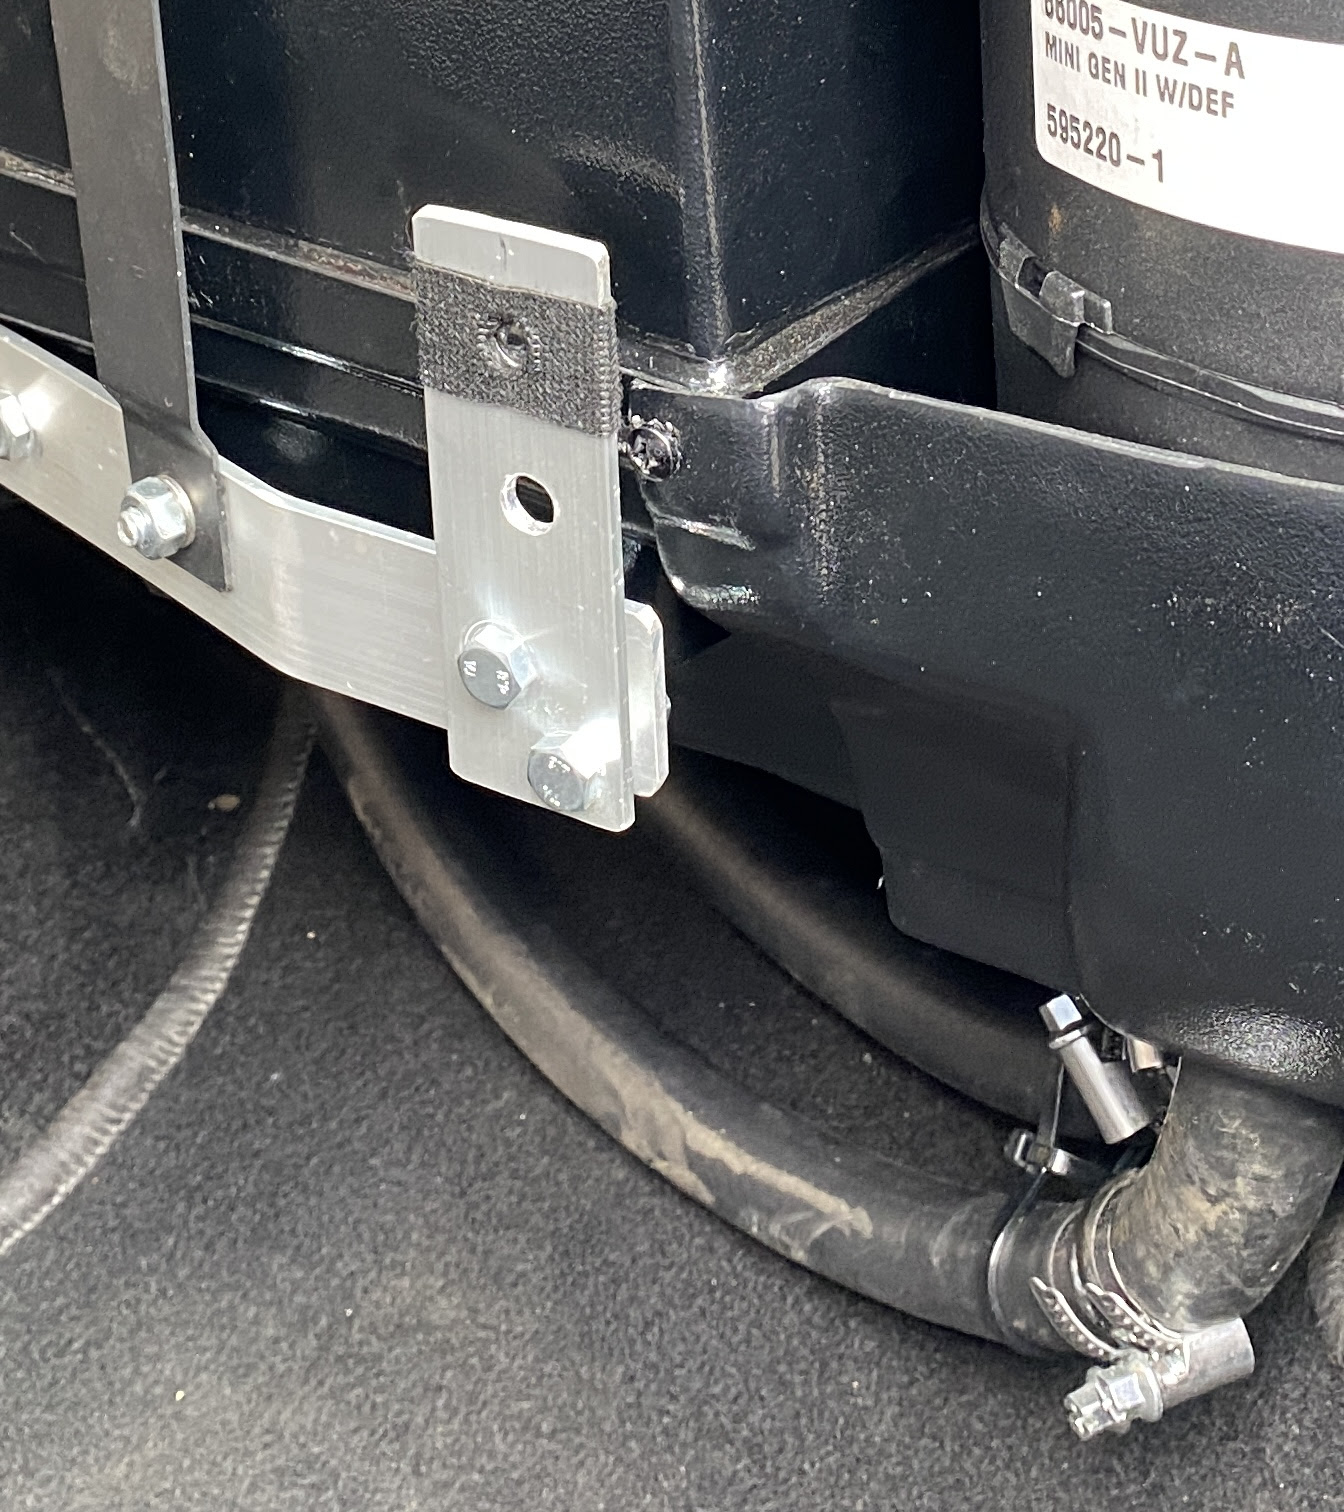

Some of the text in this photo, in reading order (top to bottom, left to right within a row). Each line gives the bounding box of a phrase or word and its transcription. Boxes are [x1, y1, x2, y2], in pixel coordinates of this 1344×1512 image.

[1044, 31, 1235, 119] MINI GEN II W/DEF
[1046, 102, 1164, 184] 595220-1
